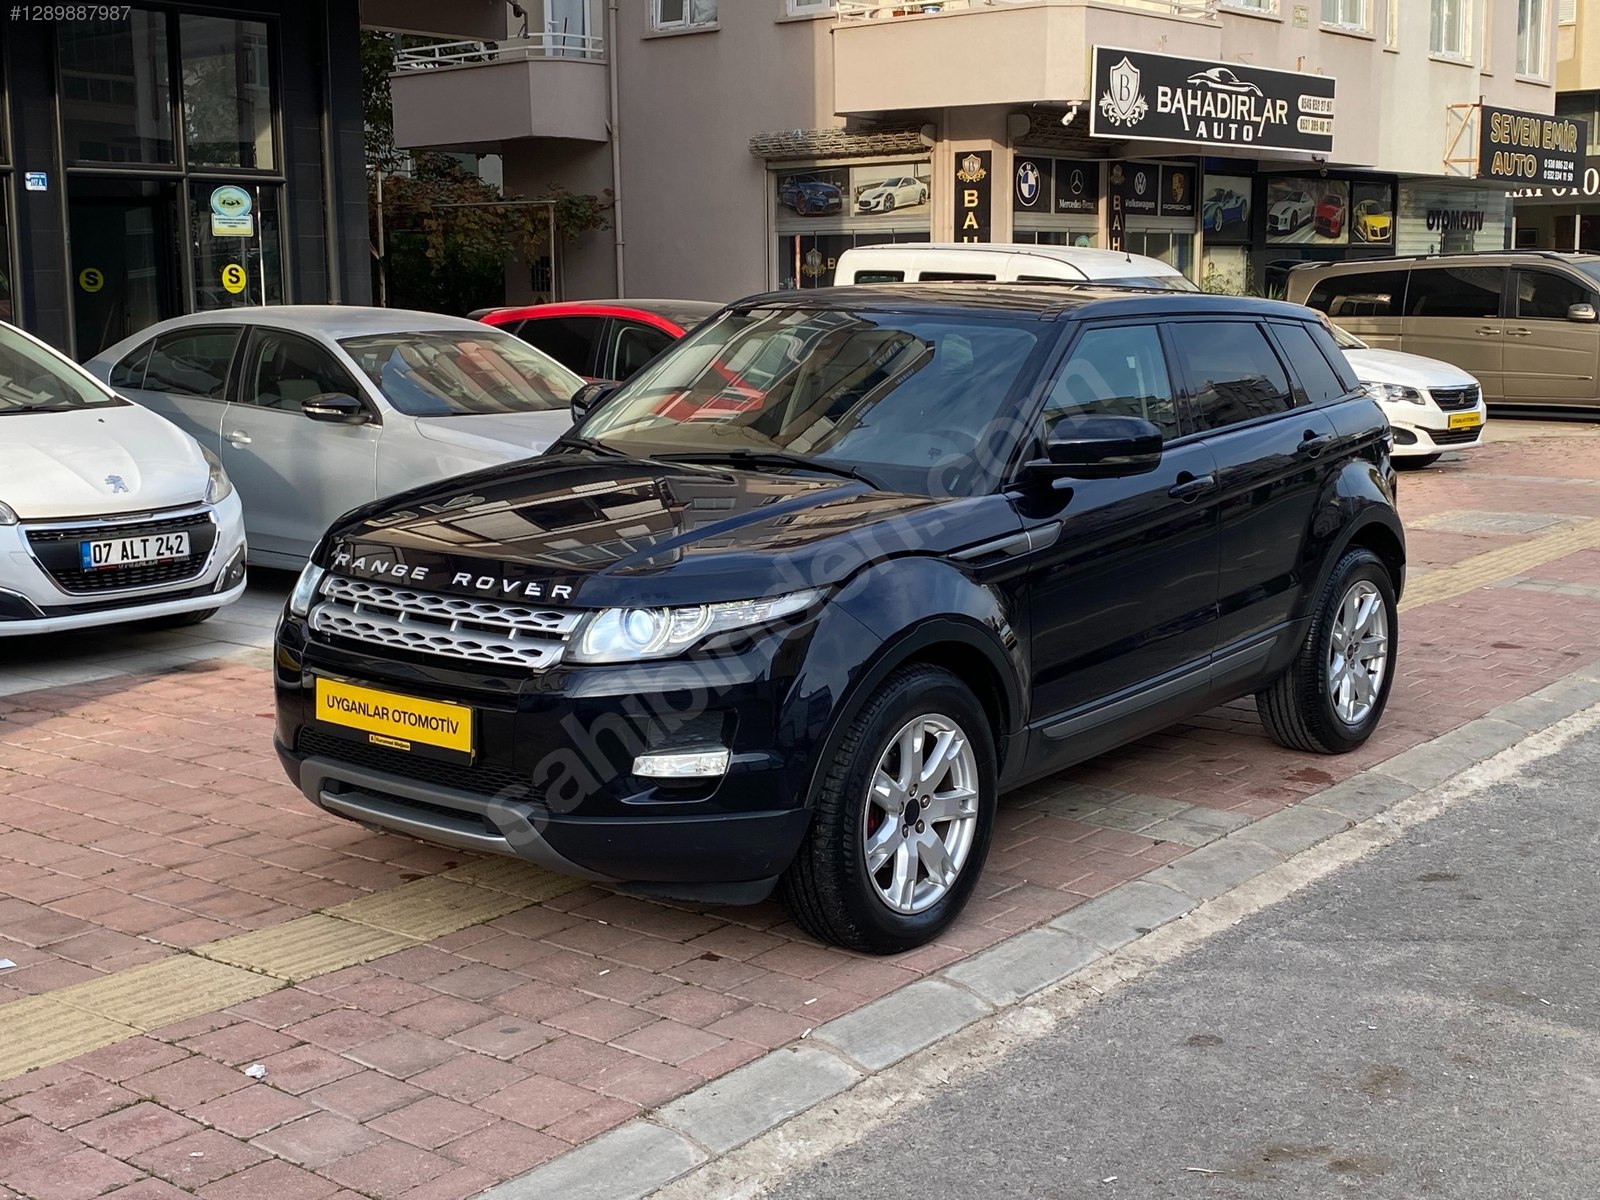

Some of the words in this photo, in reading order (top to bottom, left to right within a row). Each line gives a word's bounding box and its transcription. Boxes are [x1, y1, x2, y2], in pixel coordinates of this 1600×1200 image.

[1157, 86, 1288, 137] BAHADIRLAR
[1196, 121, 1253, 141] AUTO
[1490, 112, 1541, 149] SEVEN
[1491, 151, 1537, 178] AUTO
[1125, 199, 1155, 210] Volkswagen
[85, 271, 98, 287] S
[228, 267, 241, 285] S
[92, 543, 112, 564] 07
[121, 538, 149, 561] ALT
[155, 535, 184, 556] 242
[335, 553, 429, 581] RANGE
[452, 573, 572, 600] ROVER
[326, 694, 390, 721] UYGANLAR
[392, 709, 459, 735] OTOMOTİV
